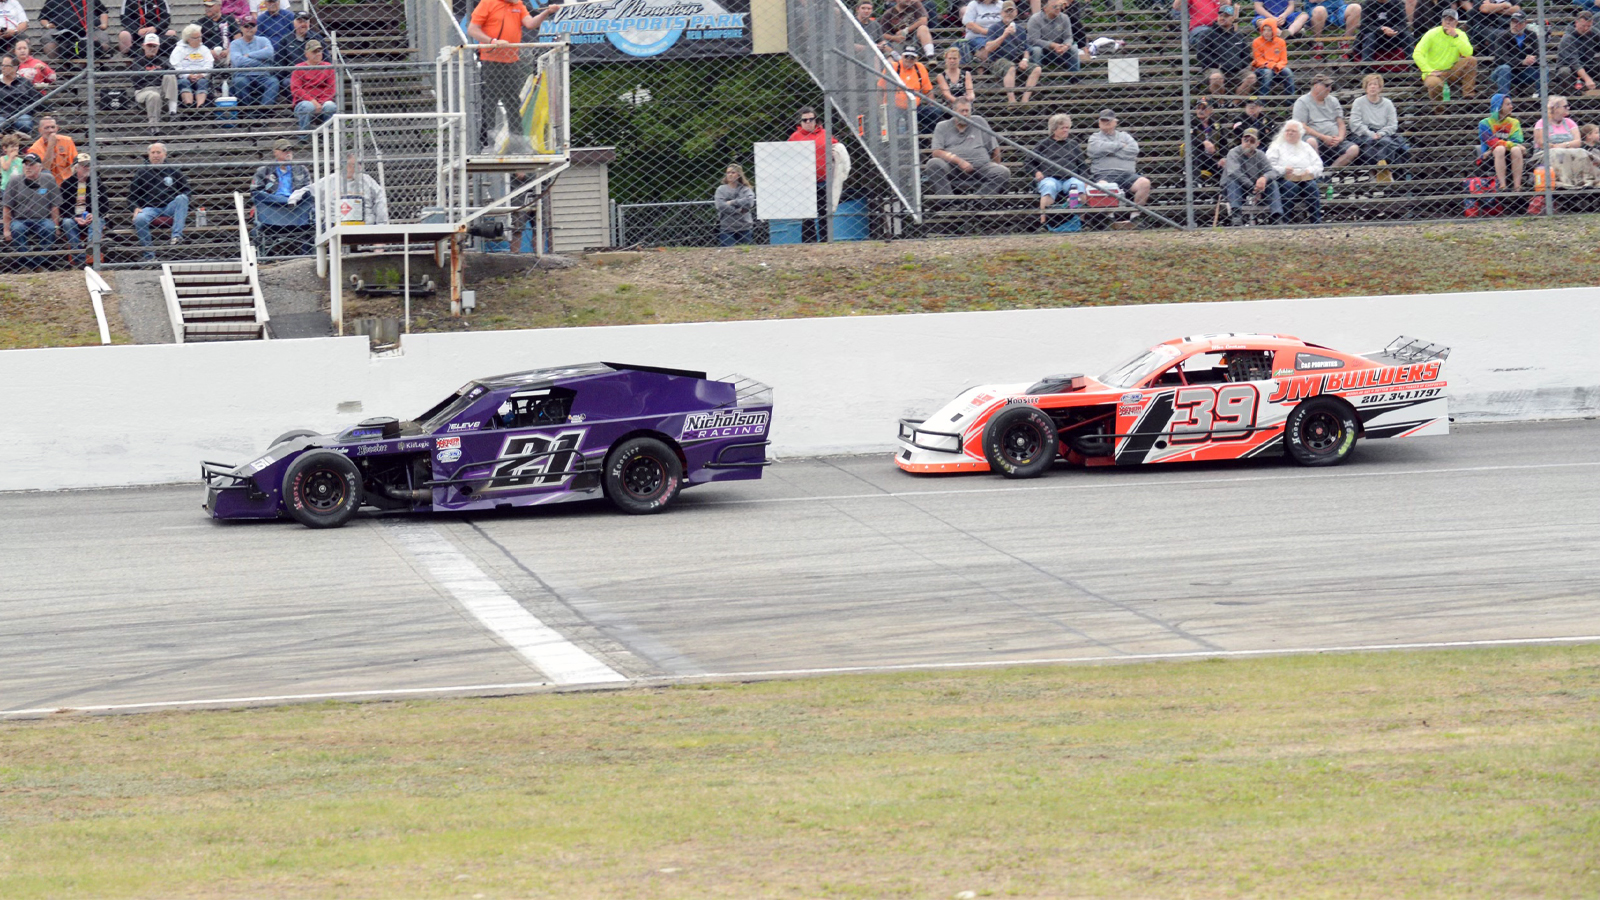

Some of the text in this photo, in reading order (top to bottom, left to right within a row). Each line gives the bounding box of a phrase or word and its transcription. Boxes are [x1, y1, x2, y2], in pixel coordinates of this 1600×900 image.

[554, 0, 704, 24] White Mountain
[538, 13, 747, 35] MOTORSPORTS PARK
[1267, 361, 1441, 403] JM BUILDERS
[1361, 388, 1441, 404] 207.341.1797
[685, 412, 767, 431] Nicholson
[1168, 384, 1259, 445] 39
[698, 425, 764, 438] RACING
[489, 429, 585, 490] 21
